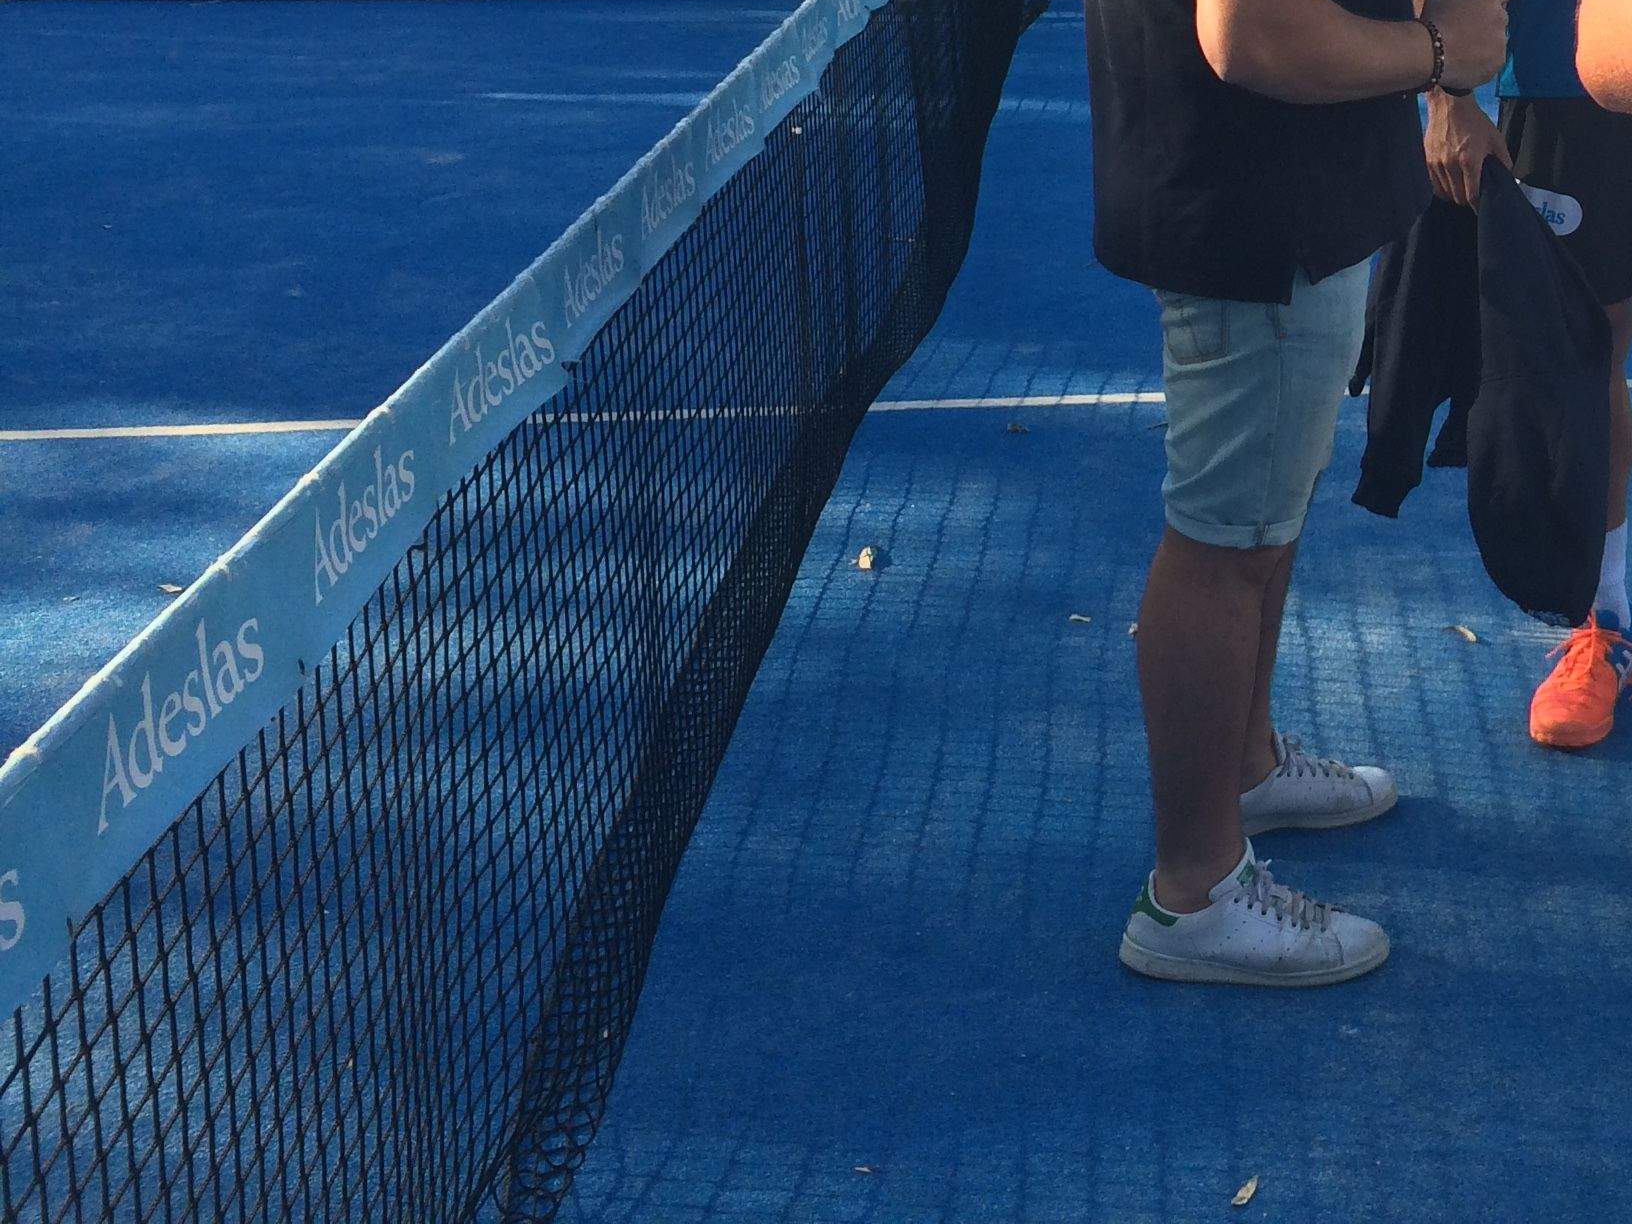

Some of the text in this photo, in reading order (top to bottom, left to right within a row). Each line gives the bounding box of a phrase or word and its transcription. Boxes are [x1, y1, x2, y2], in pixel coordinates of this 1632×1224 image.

[449, 317, 555, 447] Adeslas
[314, 444, 416, 606] Adeslas
[97, 617, 266, 837] Adeslas
